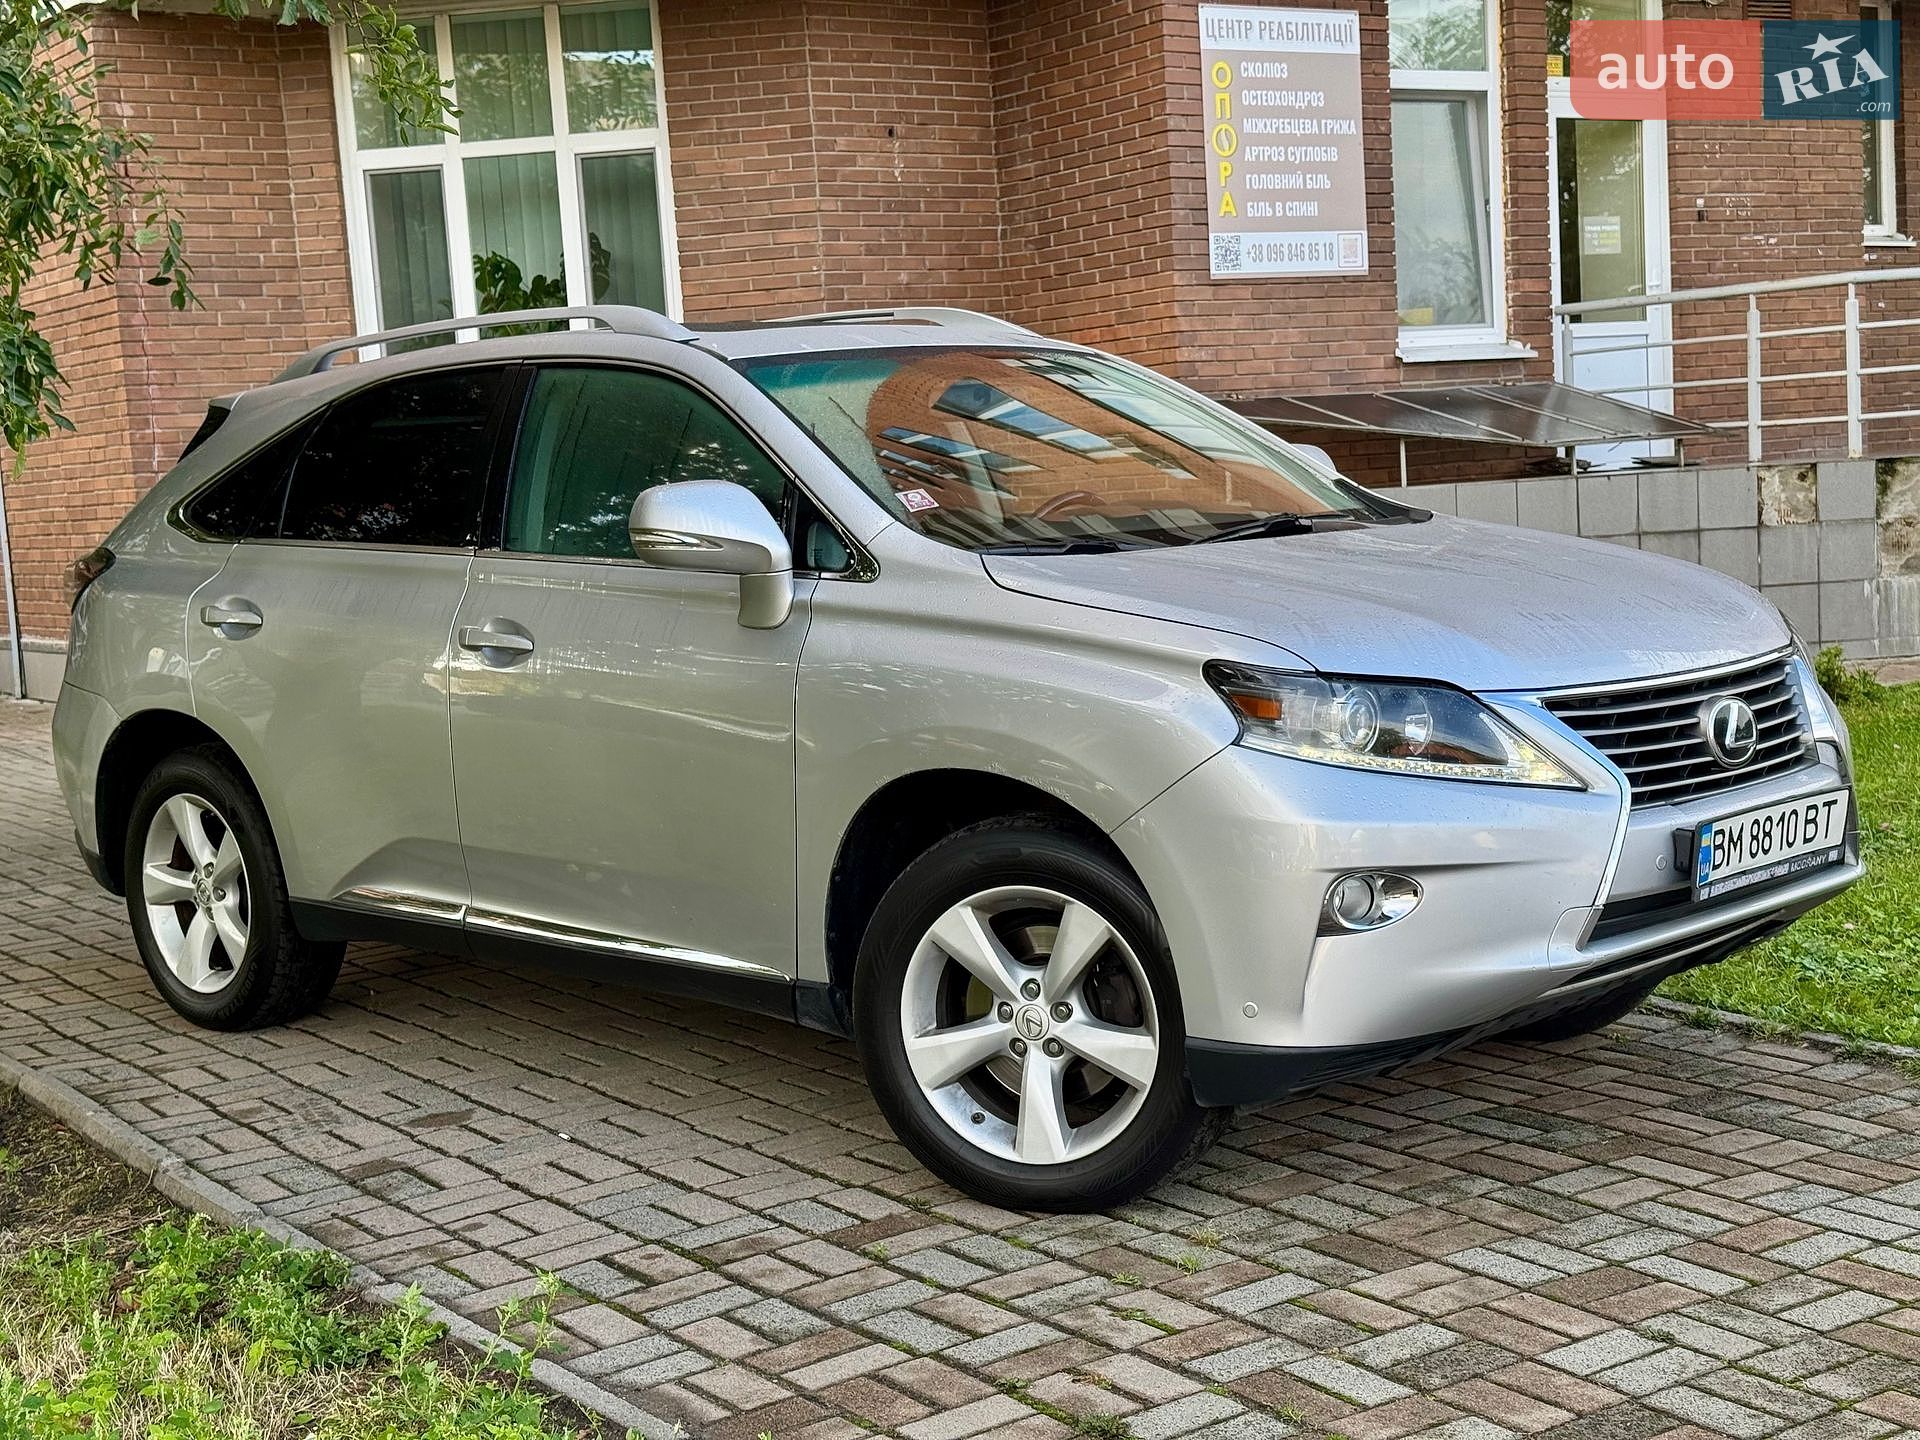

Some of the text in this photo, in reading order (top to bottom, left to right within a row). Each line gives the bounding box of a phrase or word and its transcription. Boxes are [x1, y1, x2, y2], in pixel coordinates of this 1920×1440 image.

[1205, 18, 1354, 47] ЦЕНТР РЕАБІЛІТАЦІЇ
[1241, 61, 1288, 79] СКОЛІОЗ
[1242, 91, 1325, 108] ОСТЕОХОНДРОЗ
[1243, 118, 1356, 136] МІЖХРЕБЦЕВА ГРИЖА
[1211, 60, 1238, 217] ОПОРА
[1245, 146, 1338, 163] АРТРОЗ СУГЛОБІВ
[1246, 172, 1331, 190] ГОЛОВНИЙ БІЛЬ
[1247, 201, 1318, 217] БІЛЬ В СПИНІ
[1246, 243, 1334, 263] +38 096 846 85 18
[1712, 799, 1838, 871] BM 8810 BT
[1700, 863, 1709, 876] UA
